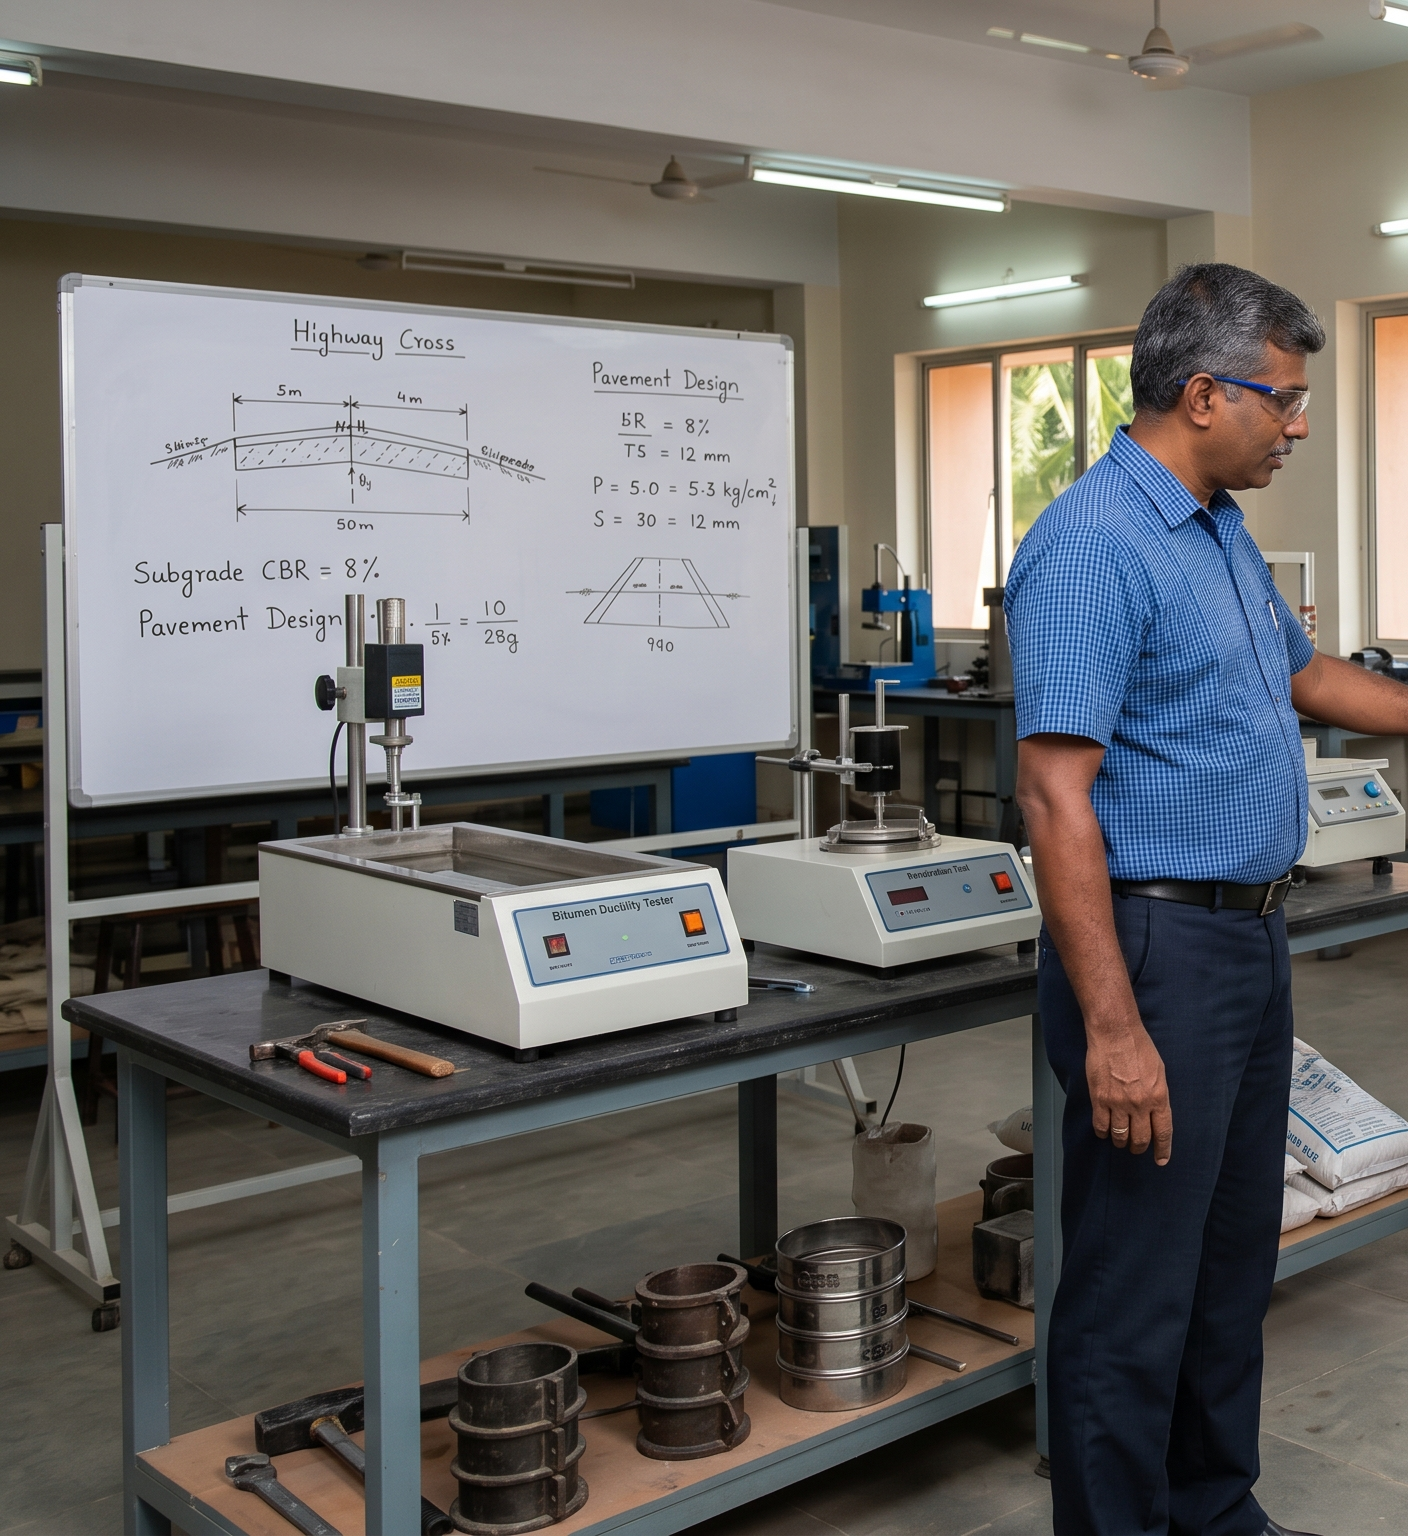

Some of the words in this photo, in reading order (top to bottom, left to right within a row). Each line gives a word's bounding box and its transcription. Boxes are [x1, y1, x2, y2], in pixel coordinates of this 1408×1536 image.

[294, 318, 384, 361] Highway
[399, 328, 455, 351] Cross
[592, 360, 672, 388] Pavement
[682, 368, 740, 404] Design
[680, 446, 697, 462] 12
[704, 452, 731, 463] mm
[593, 476, 604, 494] P
[629, 480, 660, 496] 5.0
[688, 480, 716, 497] 5.3
[593, 510, 605, 528] S
[636, 512, 657, 527] 30
[690, 513, 707, 529] 12
[712, 519, 740, 530] mm
[133, 560, 245, 599] Subgrade
[262, 559, 310, 581] CBR
[484, 600, 507, 616] 10
[139, 606, 249, 638] Pavement
[265, 606, 343, 643] Design
[552, 908, 597, 921] Bitumen
[642, 896, 674, 908] Tester
